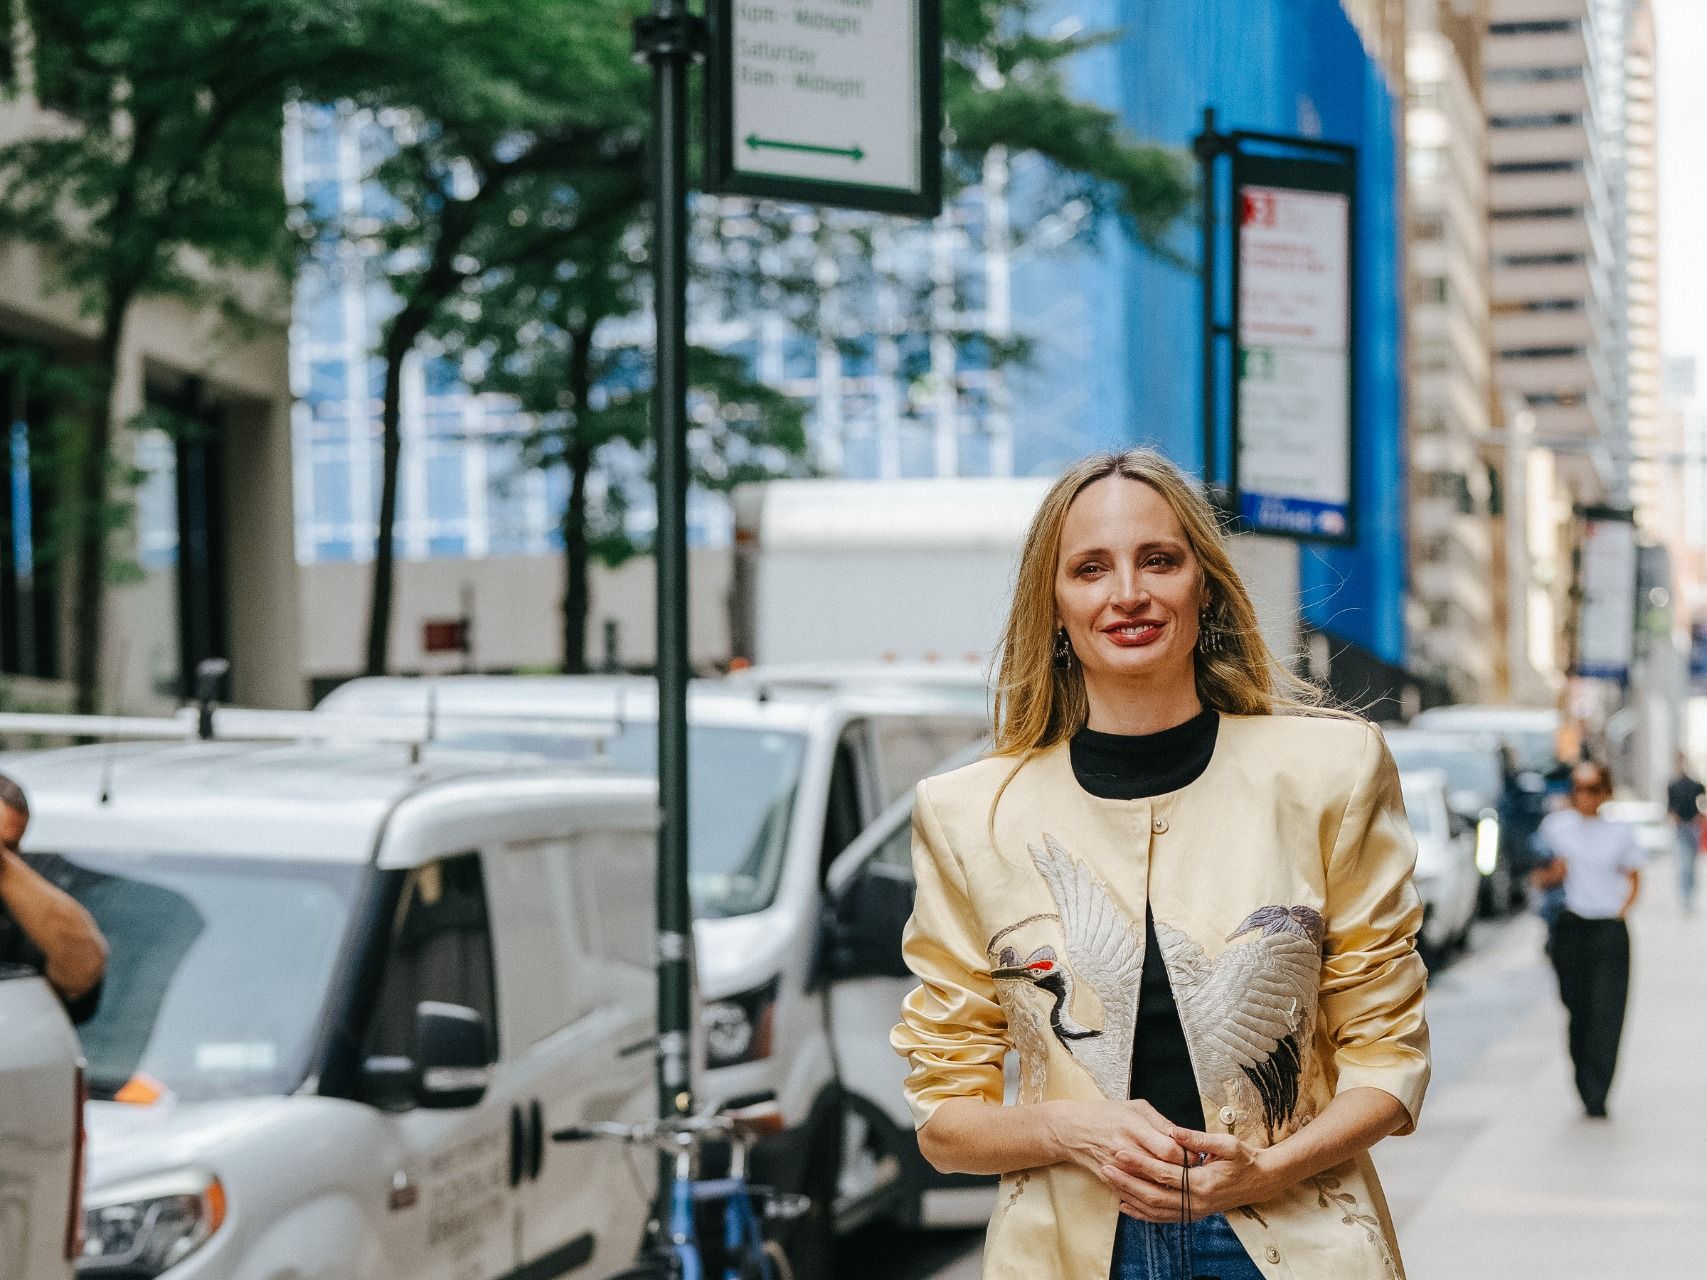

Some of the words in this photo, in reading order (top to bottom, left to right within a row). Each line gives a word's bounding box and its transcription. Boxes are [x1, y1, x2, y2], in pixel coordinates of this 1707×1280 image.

[794, 9, 860, 34] Midnight
[740, 36, 816, 65] Saturday
[794, 72, 864, 97] Midnight
